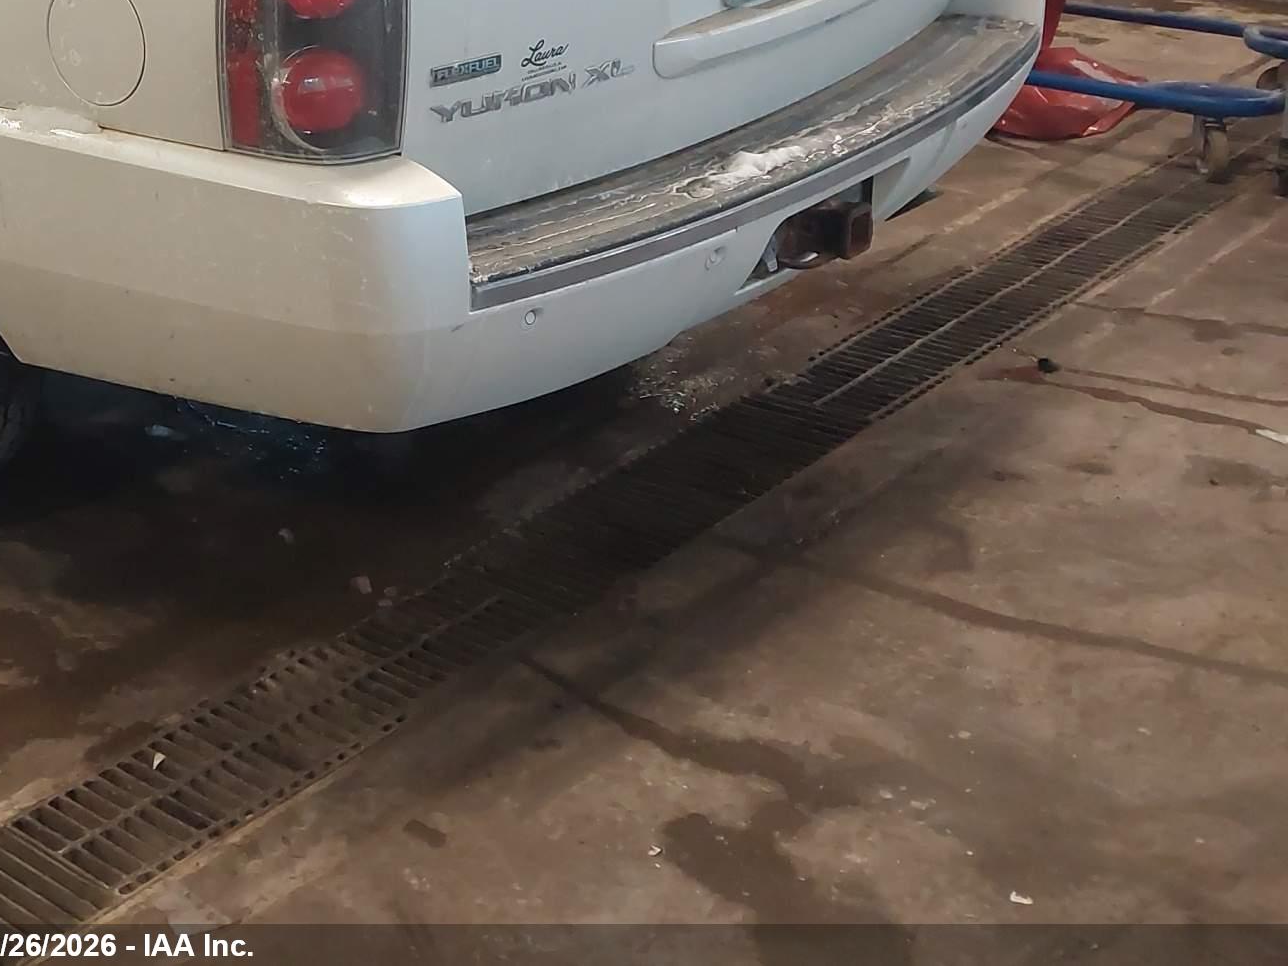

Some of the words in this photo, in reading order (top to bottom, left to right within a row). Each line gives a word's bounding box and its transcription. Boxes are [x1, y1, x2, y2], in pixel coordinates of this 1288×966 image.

[521, 39, 569, 67] Laura
[430, 72, 576, 123] YUKON
[582, 58, 634, 88] XL
